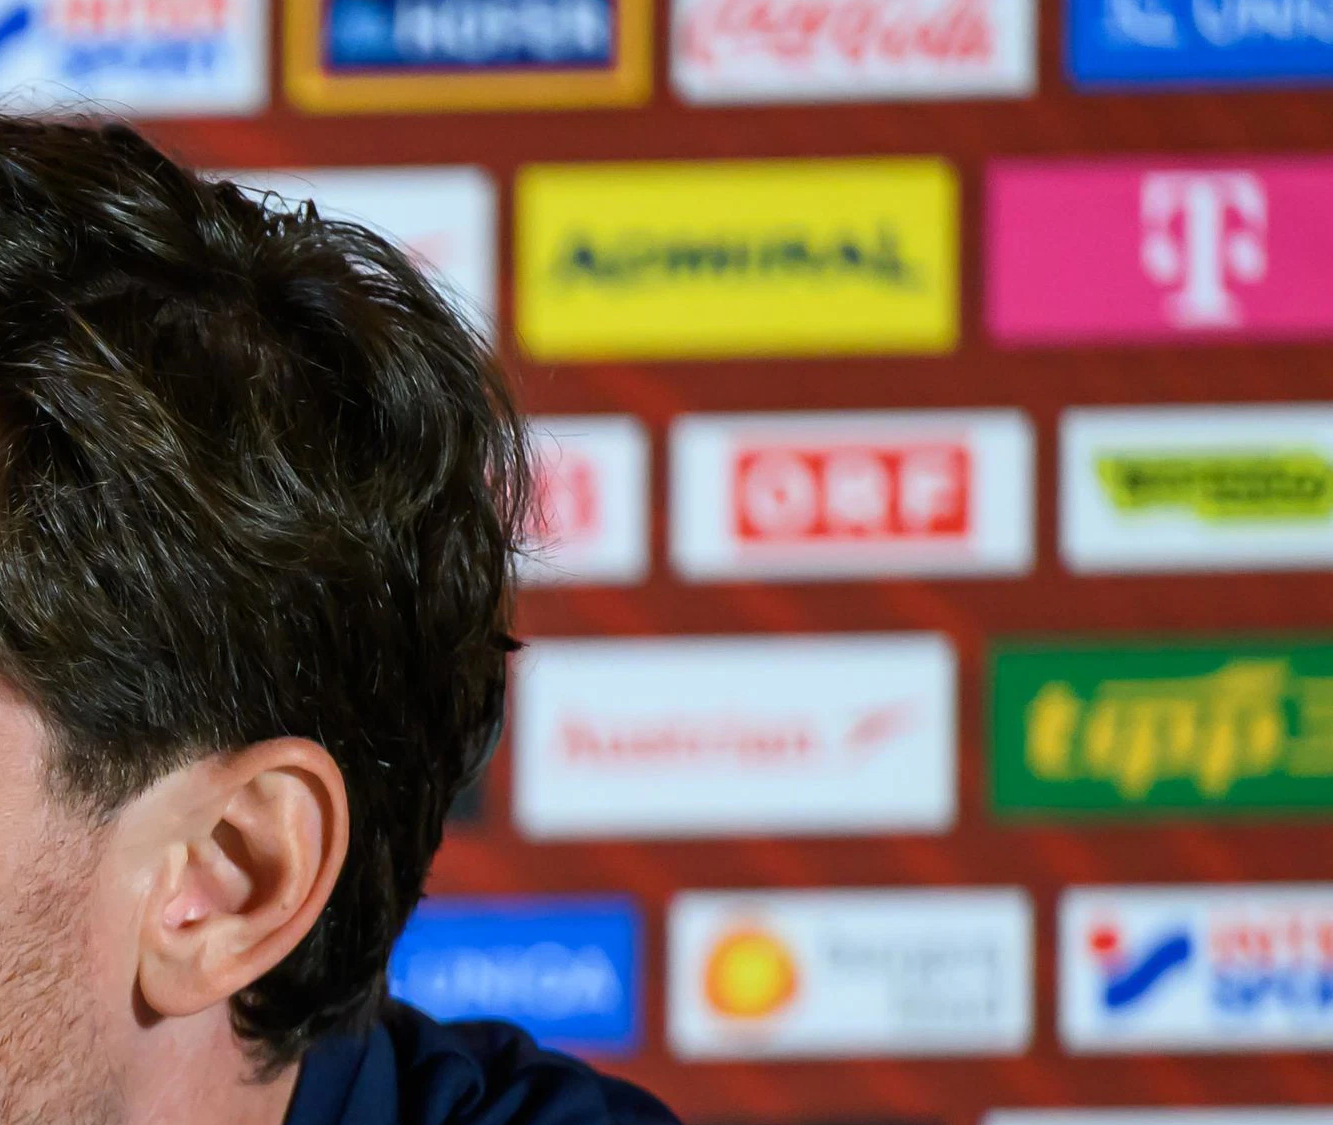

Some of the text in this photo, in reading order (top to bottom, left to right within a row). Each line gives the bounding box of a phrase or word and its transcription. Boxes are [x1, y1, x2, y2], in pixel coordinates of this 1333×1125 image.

[555, 232, 913, 292] ADMIRAL
[1140, 171, 1268, 327] T
[737, 446, 971, 542] ORF
